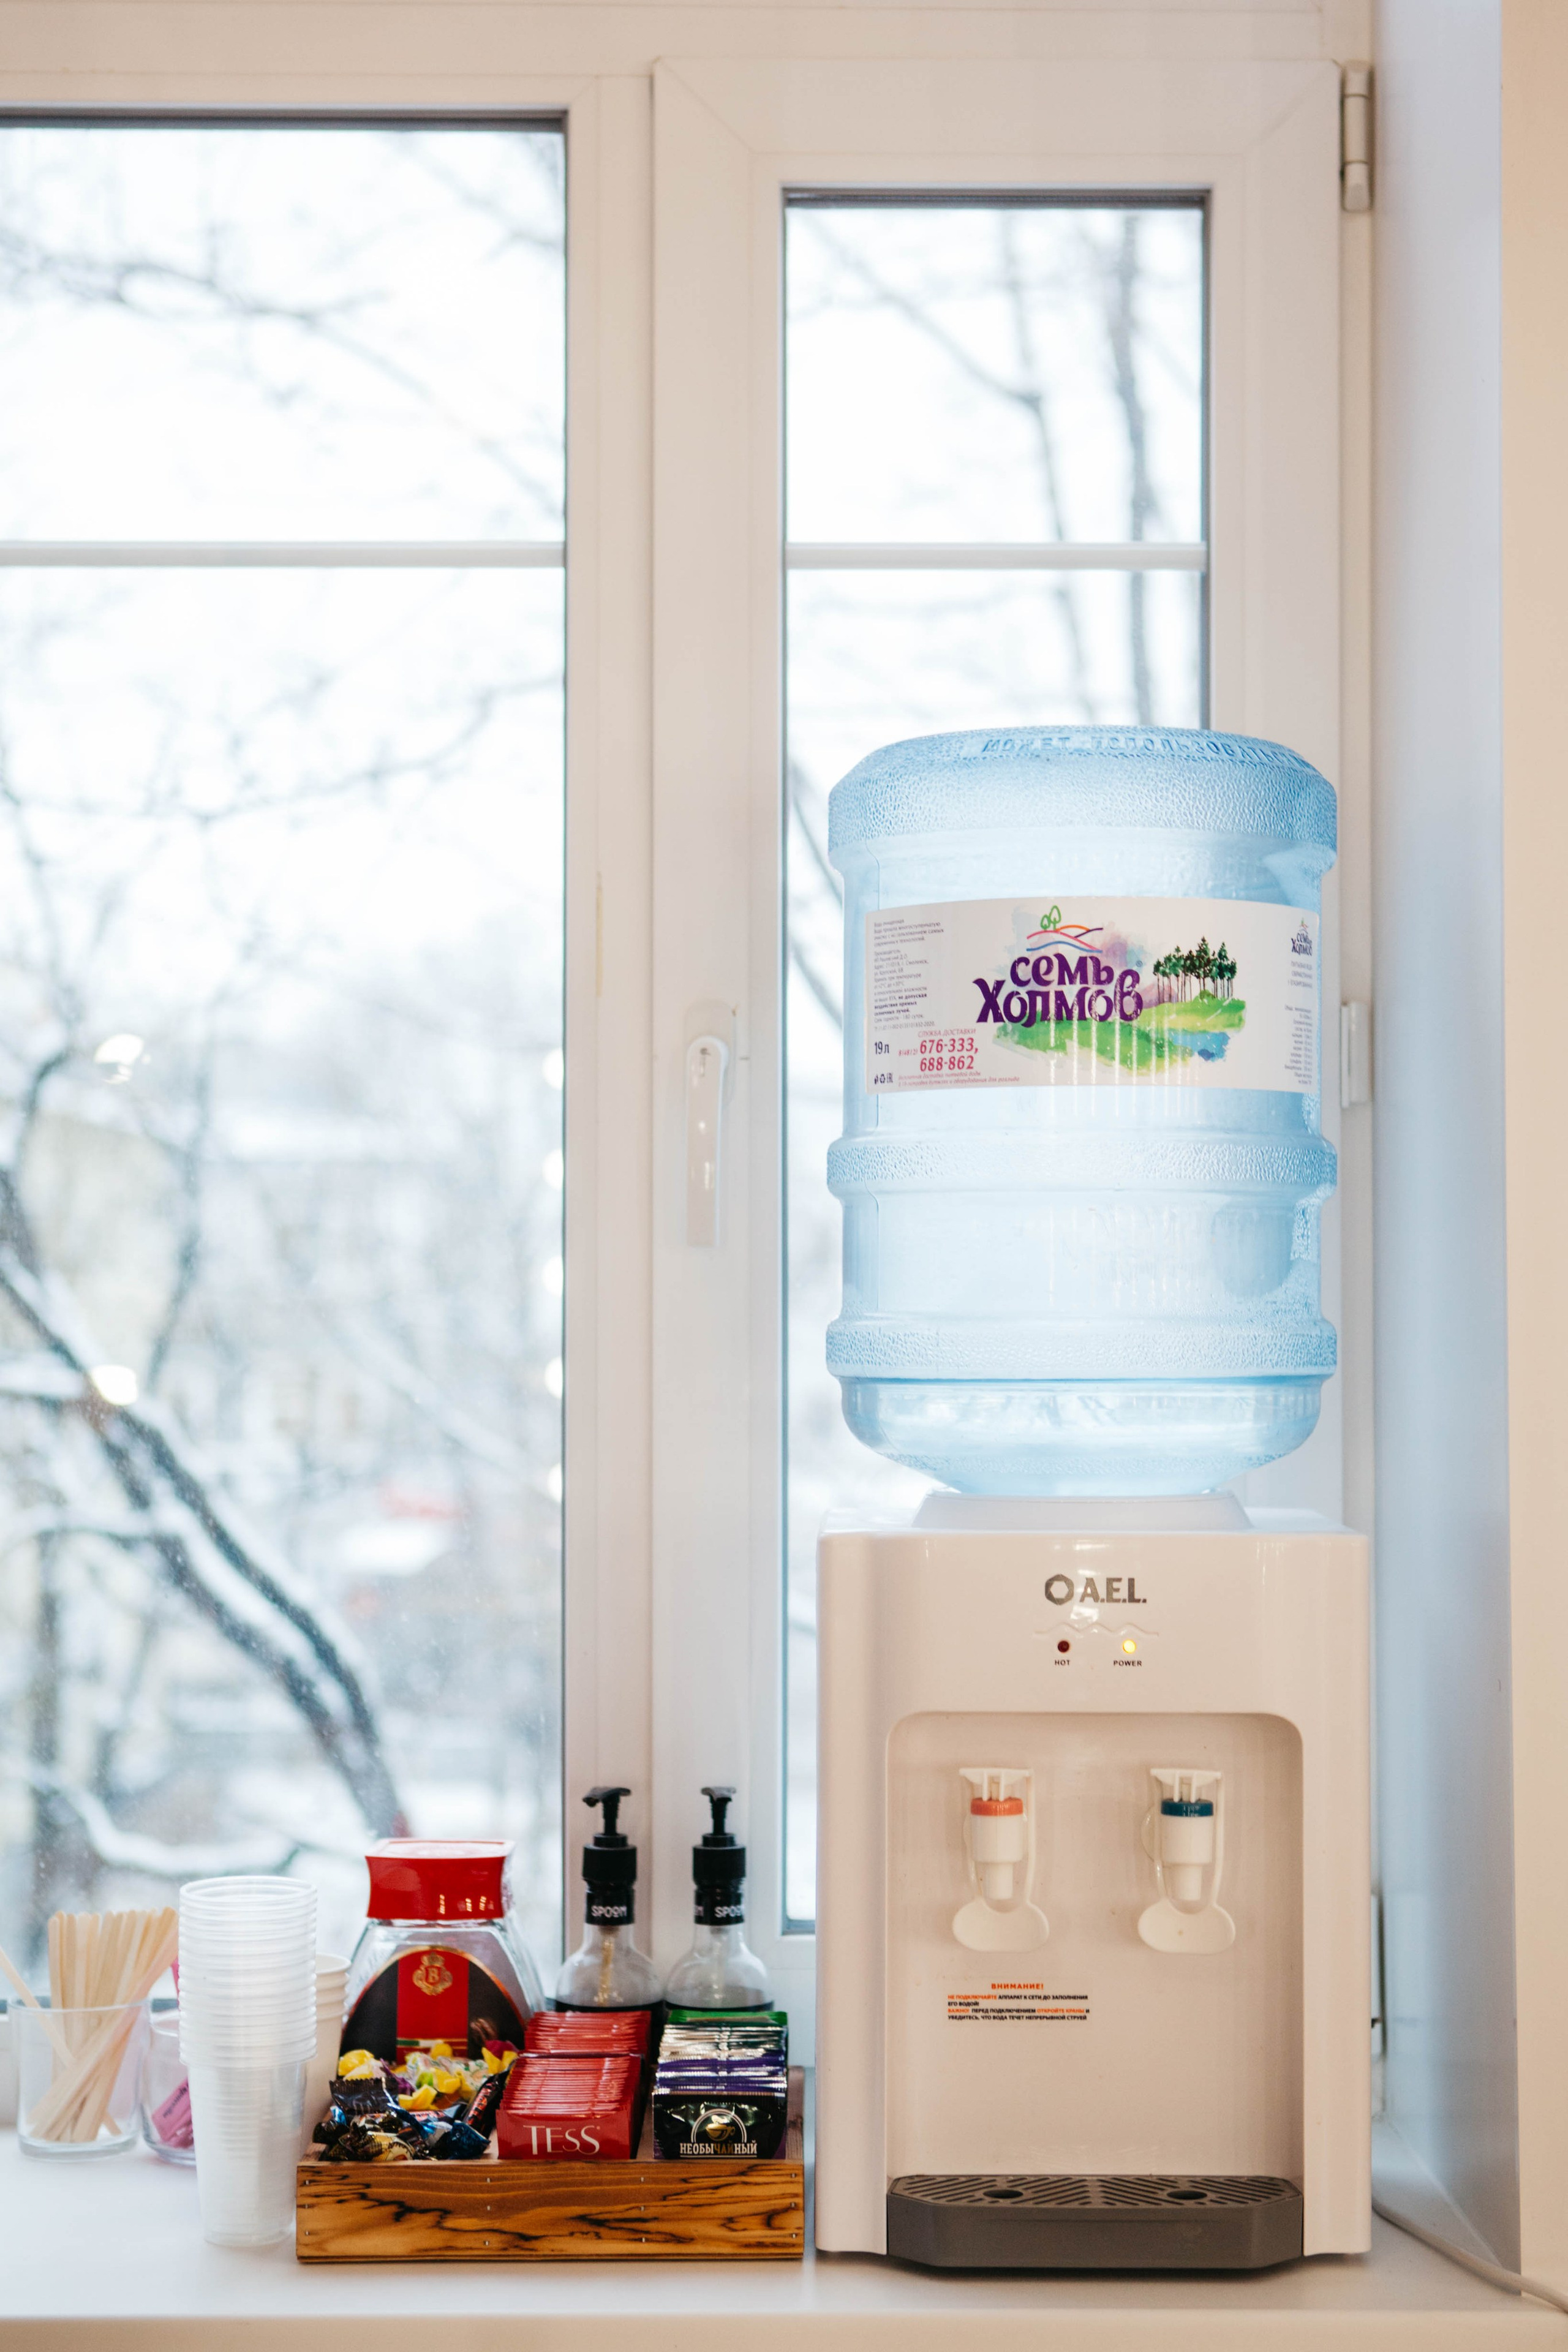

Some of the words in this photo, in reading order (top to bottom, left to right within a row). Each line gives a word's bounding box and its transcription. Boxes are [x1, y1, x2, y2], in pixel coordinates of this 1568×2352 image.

[919, 1037, 979, 1055] 676-333,
[919, 1055, 974, 1072] 688-862
[522, 2125, 600, 2156] TESS
[679, 2139, 758, 2155] НЕОБЫЧАЙНЫЙ
